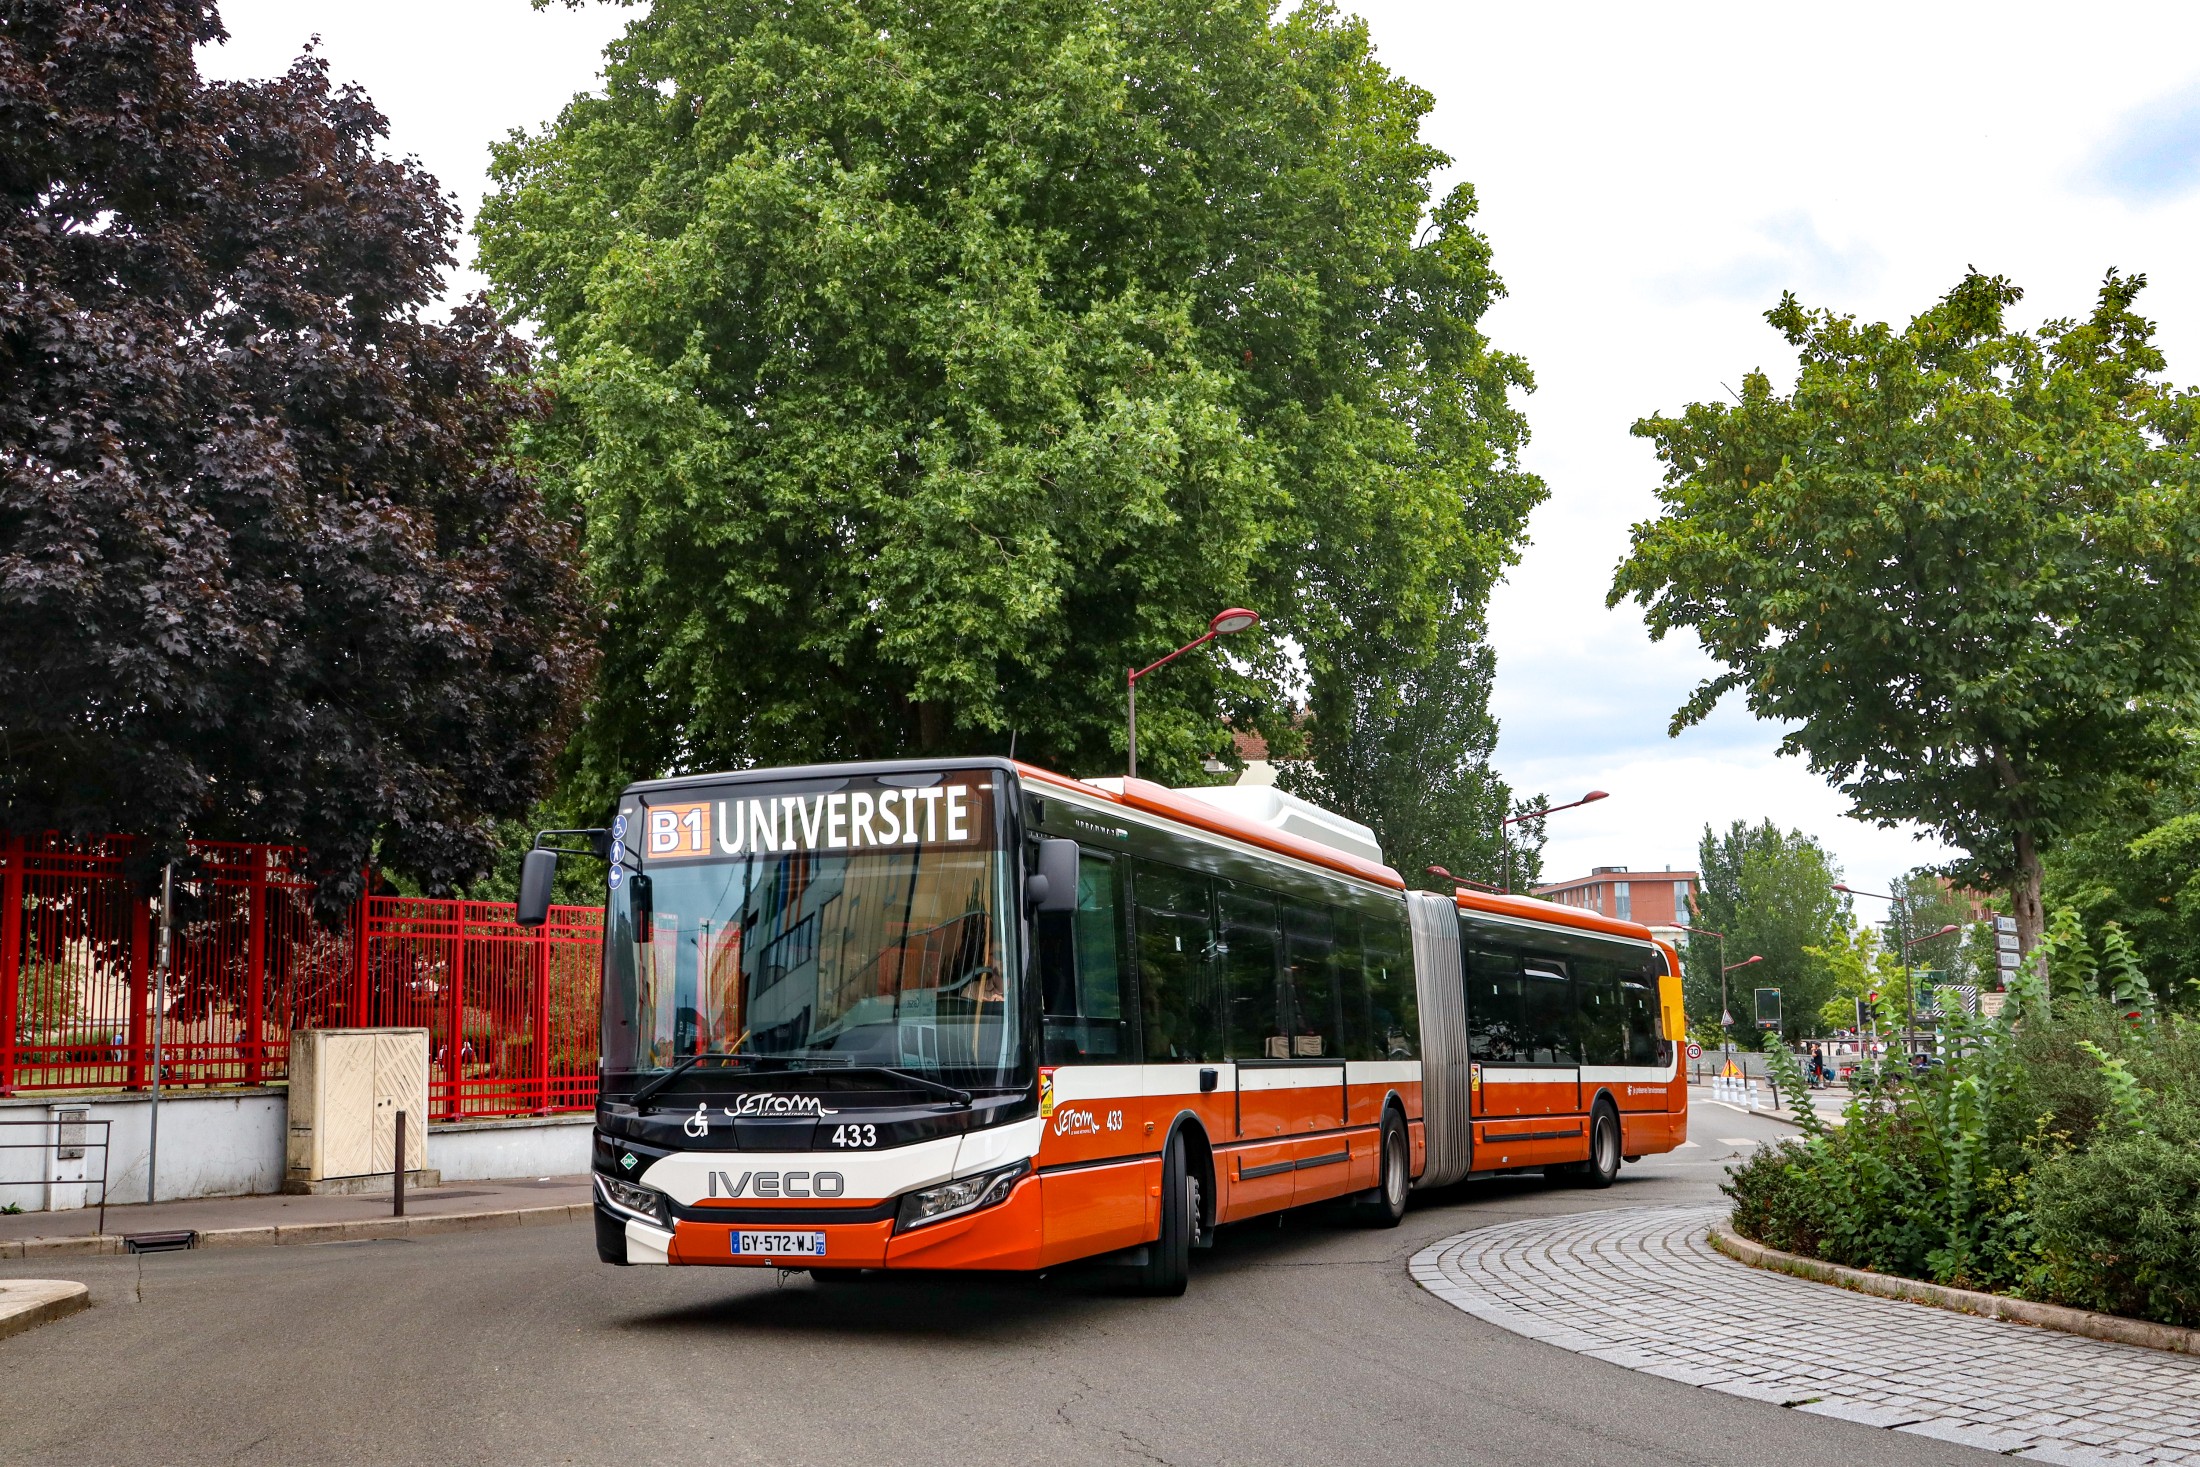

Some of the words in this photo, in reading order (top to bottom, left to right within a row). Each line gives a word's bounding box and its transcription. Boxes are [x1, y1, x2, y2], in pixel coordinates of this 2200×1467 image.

[651, 807, 702, 853] B1
[718, 784, 968, 855] UNIVERSITE
[1106, 1109, 1123, 1131] 433
[831, 1123, 877, 1148] 433
[708, 1171, 844, 1198] IVECO
[742, 1235, 815, 1252] GY-572-WJ
[816, 1244, 825, 1254] 72
